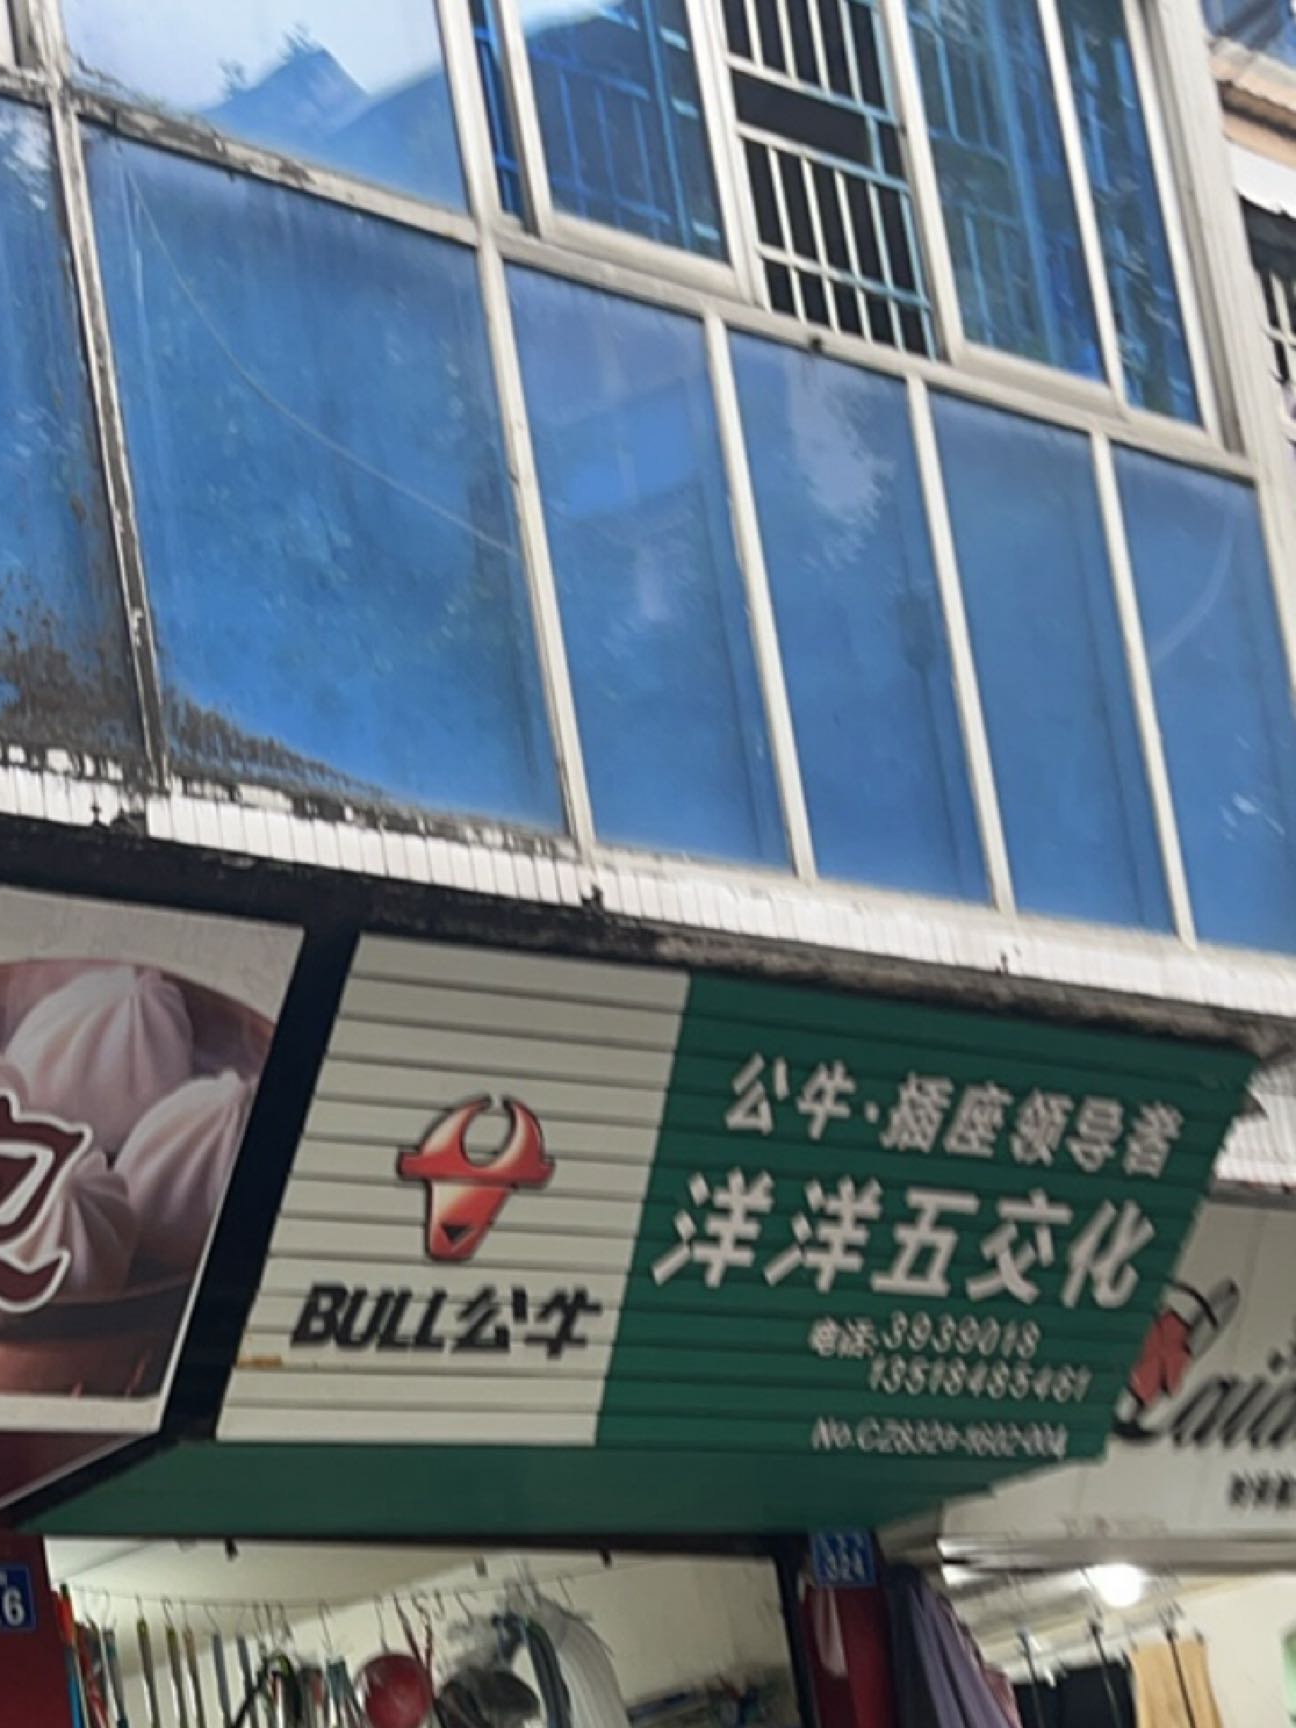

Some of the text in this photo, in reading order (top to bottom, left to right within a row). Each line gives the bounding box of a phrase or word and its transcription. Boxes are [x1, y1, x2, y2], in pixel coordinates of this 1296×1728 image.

[652, 1168, 1156, 1310] 洋洋五交化
